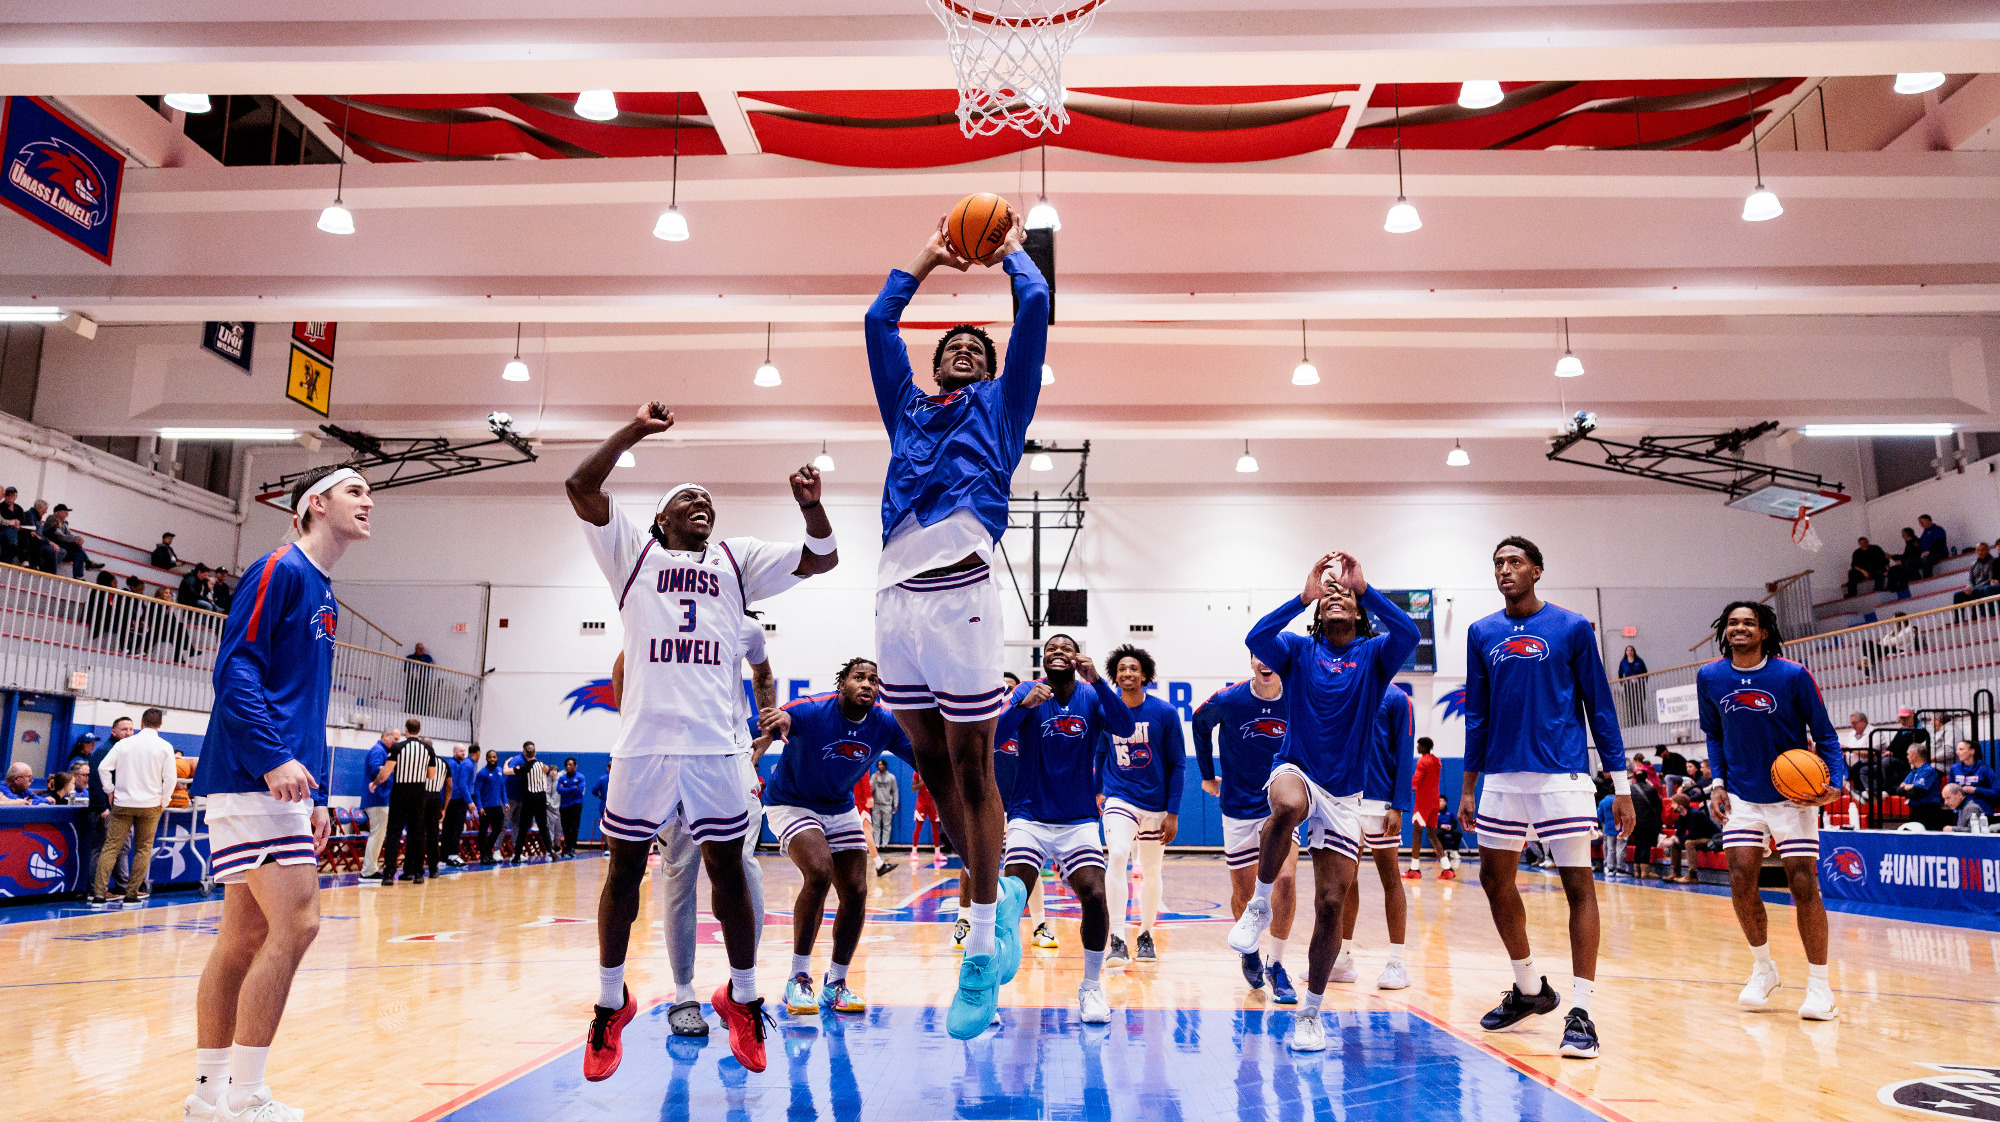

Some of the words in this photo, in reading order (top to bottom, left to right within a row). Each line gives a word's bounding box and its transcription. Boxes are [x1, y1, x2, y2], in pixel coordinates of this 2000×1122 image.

[12, 164, 51, 201] UMASS
[50, 187, 91, 225] LOWELL
[218, 325, 242, 349] UNH
[656, 568, 719, 597] UMASS
[678, 599, 697, 632] 3
[649, 638, 721, 665] LOWELL
[1114, 744, 1131, 766] US
